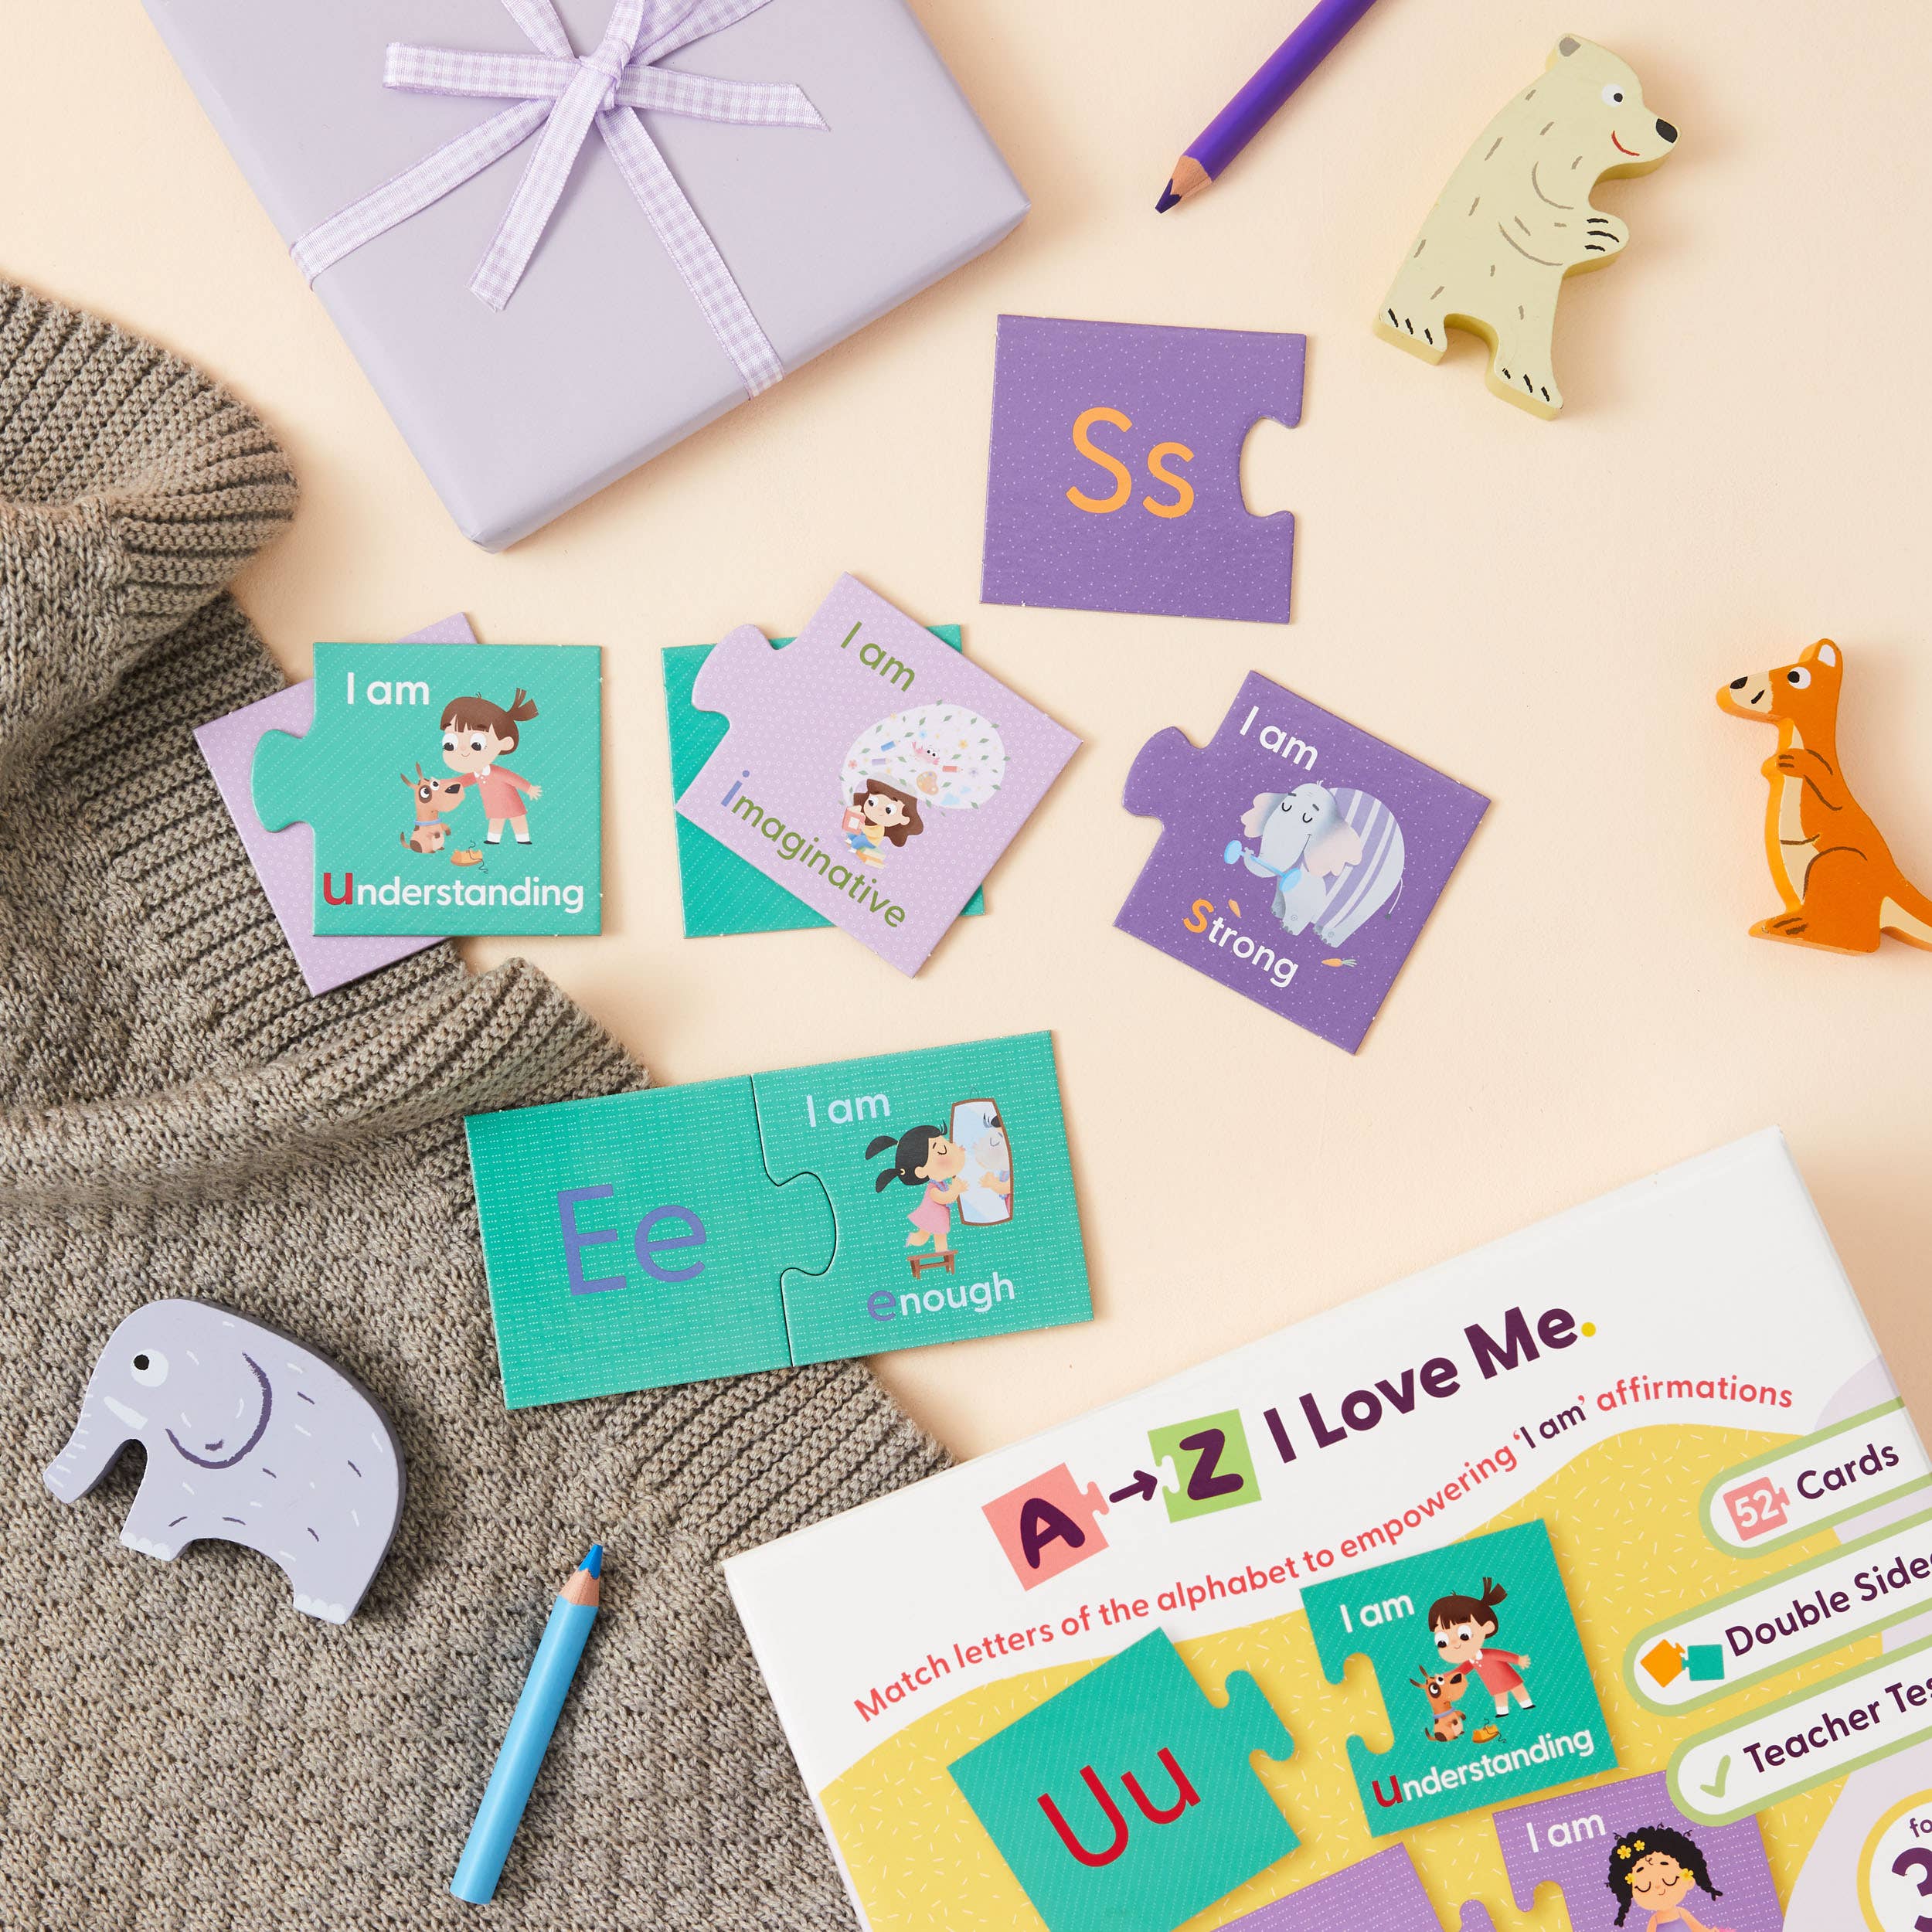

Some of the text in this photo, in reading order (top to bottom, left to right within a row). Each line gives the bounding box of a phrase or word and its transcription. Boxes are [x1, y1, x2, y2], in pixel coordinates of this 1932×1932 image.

[1065, 406, 1195, 519] Ss
[346, 672, 430, 706] I am
[840, 621, 915, 692] I am
[1239, 705, 1319, 771] I am
[720, 770, 906, 928] imaginative
[806, 1091, 890, 1128] I am
[557, 1184, 707, 1297] Ee
[868, 1271, 1015, 1322] enough
[1020, 1306, 1597, 1569] A Z I Love Me.
[1734, 1444, 1900, 1527] 52 Cards
[854, 1654, 951, 1723] Match
[953, 1624, 1055, 1666] letters
[1061, 1605, 1090, 1636] of
[1097, 1597, 1150, 1627] the
[1157, 1559, 1300, 1611] alphabet
[1303, 1547, 1335, 1573] to
[1340, 1441, 1519, 1559] empowering
[1596, 1374, 1794, 1413] affirmations
[1340, 1594, 1415, 1633] I am
[1725, 1556, 1932, 1657] Double Side
[1743, 1701, 1880, 1774] Teacher
[1037, 1747, 1201, 1867] Uu
[1526, 1814, 1607, 1853] I am
